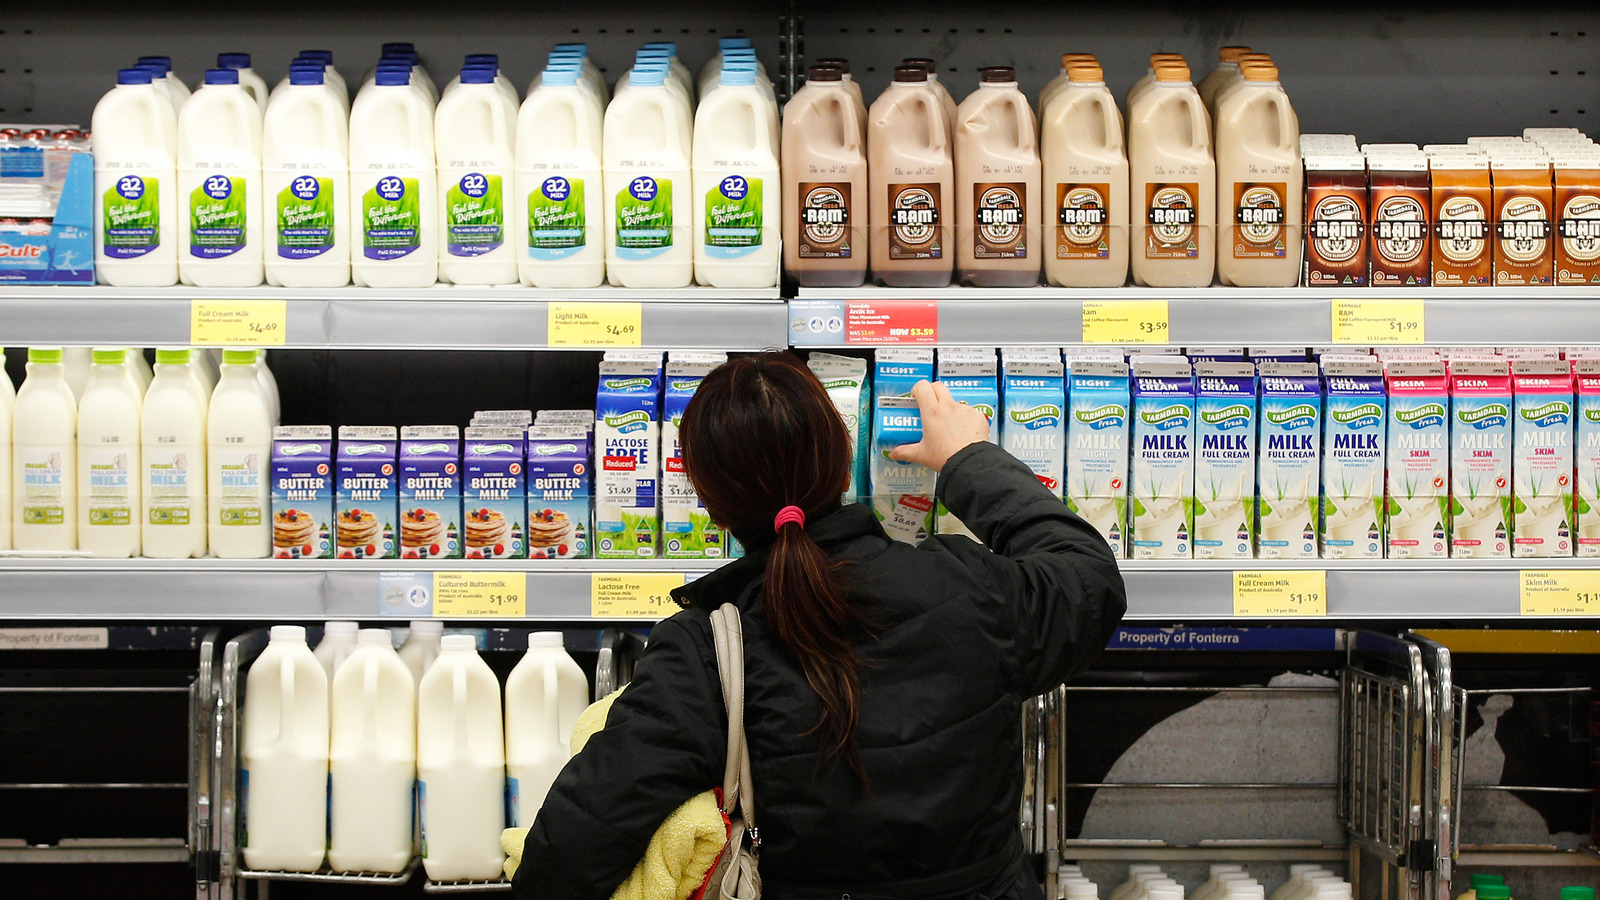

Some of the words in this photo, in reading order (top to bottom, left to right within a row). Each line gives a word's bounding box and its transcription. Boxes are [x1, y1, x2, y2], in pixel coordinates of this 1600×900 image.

[120, 177, 142, 192] a2
[207, 177, 229, 192] a2
[295, 178, 317, 192] a2
[464, 175, 485, 189] a2
[546, 179, 567, 192] a2
[724, 177, 745, 191] a2
[283, 206, 298, 217] Feel
[298, 204, 312, 213] the
[711, 206, 727, 217] Feel
[727, 204, 740, 214] the
[807, 208, 843, 223] RAM
[1242, 208, 1278, 222] RAM
[1324, 204, 1351, 215] FARMDALE
[1387, 205, 1414, 215] FARMDALE
[1510, 205, 1537, 215] FARMDALE
[287, 210, 326, 225] Difference
[715, 210, 754, 225] Difference
[897, 209, 933, 224] RAM
[1065, 209, 1101, 223] RAM
[1316, 221, 1357, 238] RAM
[1380, 222, 1420, 238] RAM
[1441, 221, 1482, 237] RAM
[1503, 221, 1544, 237] RAM
[249, 322, 277, 333] $4.69
[606, 325, 634, 336] $4.69
[890, 328, 909, 336] NOW
[910, 328, 935, 336] $3.59
[1139, 322, 1167, 333] $3.59
[1390, 321, 1418, 332] $1.99
[1266, 383, 1305, 391] CREAM
[1015, 407, 1054, 421] FARMDALE
[1080, 407, 1119, 421] FARMDALE
[1146, 407, 1184, 421] FARMDALE
[1207, 407, 1244, 421] FARMDALE
[1272, 407, 1310, 421] FARMDALE
[1338, 406, 1376, 421] FARMDALE
[1401, 407, 1439, 420] FARMDALE
[1463, 407, 1501, 421] FARMDALE
[1526, 404, 1563, 419] FARMDALE
[609, 412, 644, 426] FARMDALE
[883, 416, 919, 427] LIGHT
[1033, 418, 1053, 428] fresh
[1098, 418, 1118, 428] fresh
[1164, 419, 1183, 429] fresh
[1224, 419, 1243, 429] fresh
[1289, 419, 1309, 429] fresh
[1355, 418, 1374, 428] fresh
[1418, 418, 1438, 428] fresh
[1481, 418, 1500, 428] fresh
[1543, 416, 1563, 426] fresh
[625, 423, 643, 433] fresh
[605, 438, 648, 448] LACTOSE
[1011, 433, 1057, 450] MILK
[1076, 433, 1122, 450] MILK
[1142, 434, 1187, 450] MILK
[1202, 434, 1248, 450] MILK
[1268, 434, 1313, 450] MILK
[1333, 434, 1379, 449] MILK
[1397, 433, 1442, 449] MILK
[1460, 433, 1505, 449] MILK
[1522, 431, 1567, 447] MILK
[606, 459, 634, 468] Reduced
[883, 466, 928, 478] MILK
[91, 475, 127, 485] MILK
[150, 475, 186, 485] MILK
[279, 478, 325, 490] BUTTER
[343, 478, 389, 490] BUTTER
[407, 477, 452, 489] BUTTER
[471, 478, 517, 489] BUTTER
[287, 489, 317, 501] MILK
[351, 489, 382, 501] MILK
[414, 489, 445, 501] MILK
[479, 489, 510, 501] MILK
[608, 487, 631, 495] $1.49
[489, 594, 518, 606] $1.99
[649, 595, 671, 606] $1.9
[1290, 593, 1318, 604] $1.19
[1577, 592, 1600, 604] $1.1
[44, 633, 54, 642] of
[56, 633, 100, 642] Fonterra
[1119, 632, 1170, 644] Property
[1174, 632, 1186, 642] of
[1189, 632, 1239, 643] Fonterra
